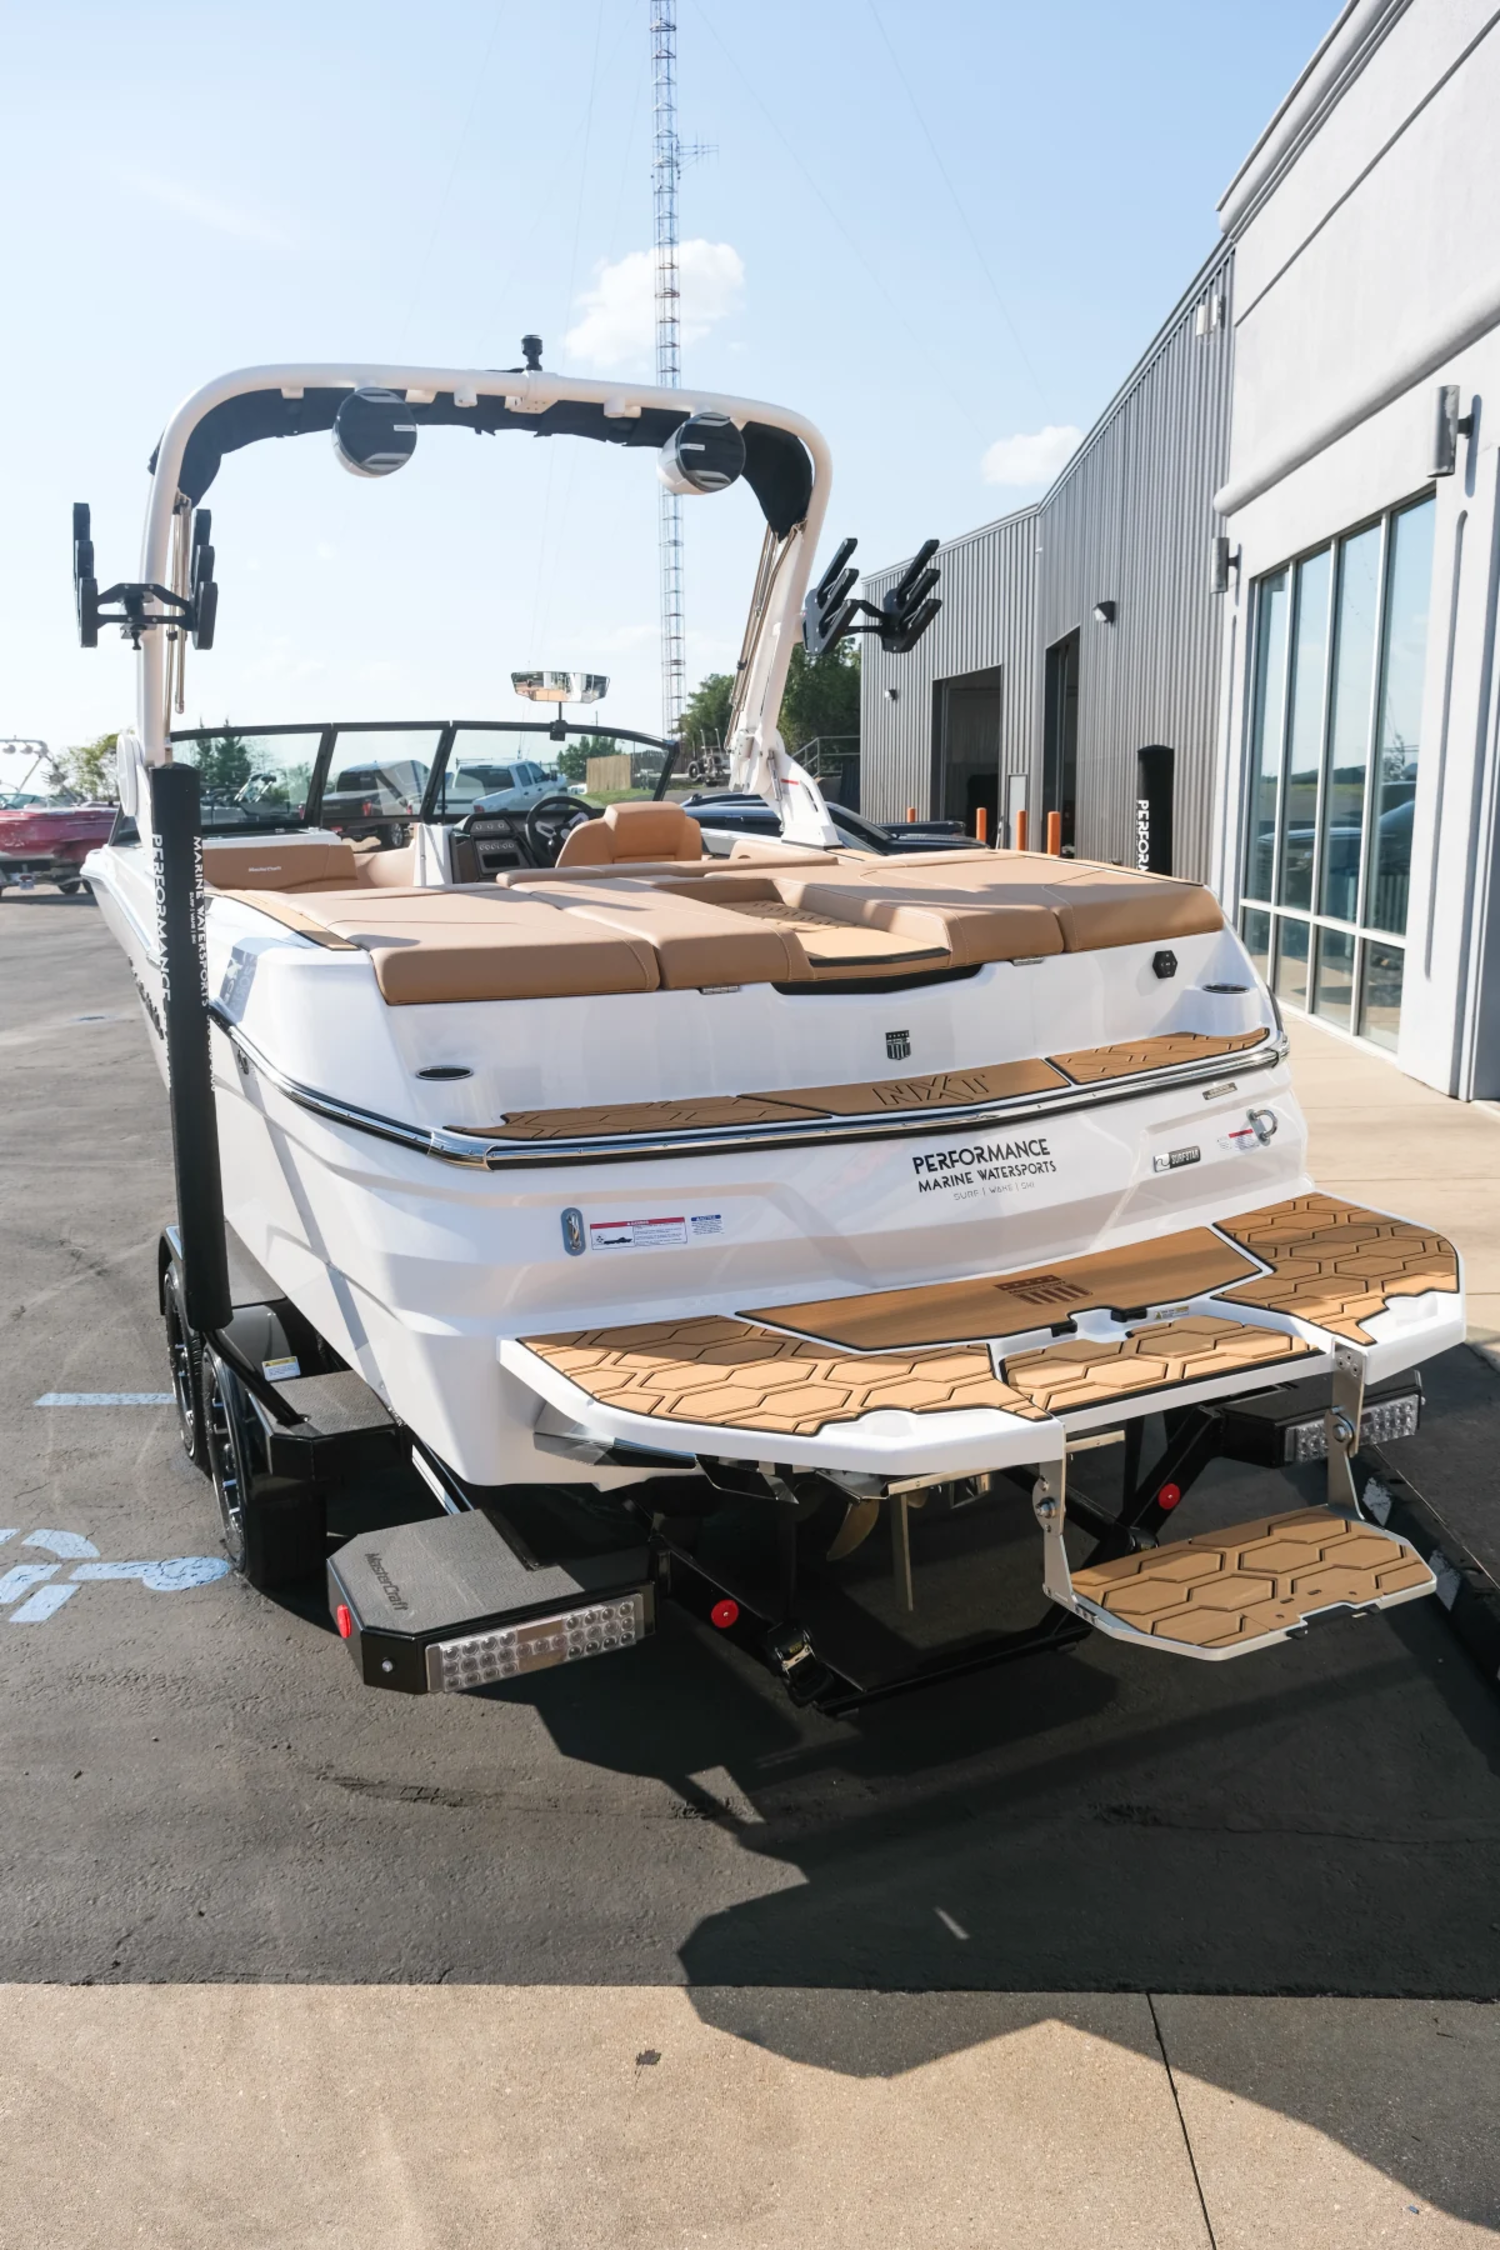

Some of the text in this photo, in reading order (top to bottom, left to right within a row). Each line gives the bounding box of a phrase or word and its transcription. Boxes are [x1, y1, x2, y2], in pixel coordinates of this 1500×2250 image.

[193, 836, 209, 1007] MARINE WATERSPORTS
[872, 1074, 989, 1106] NXT
[912, 1138, 1051, 1175] PERFORMANCE
[918, 1160, 1057, 1193] MARINE WATERSPORTS
[953, 1189, 980, 1201] SURF
[364, 1552, 409, 1611] MasterCraft
